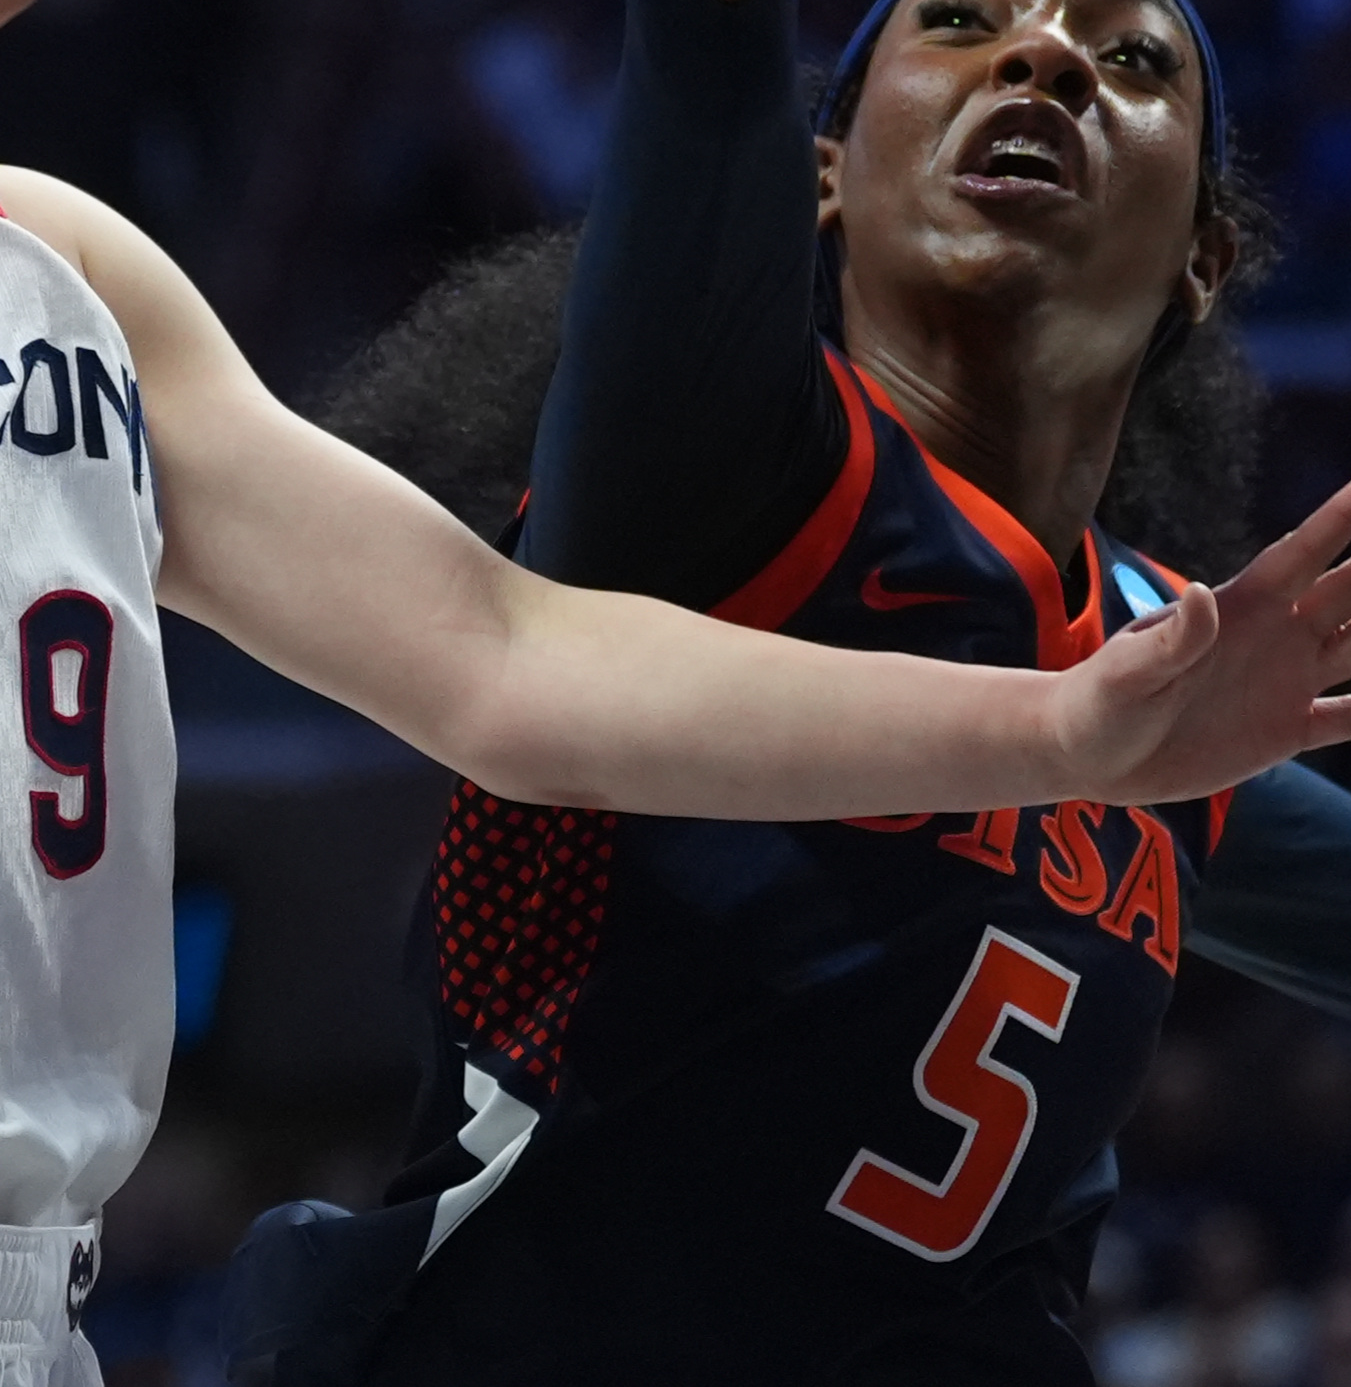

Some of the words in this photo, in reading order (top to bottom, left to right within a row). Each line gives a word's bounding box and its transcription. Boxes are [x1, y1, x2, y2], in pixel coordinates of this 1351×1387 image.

[19, 589, 114, 880] 9
[838, 799, 1180, 978] SA
[825, 924, 1081, 1263] 5
